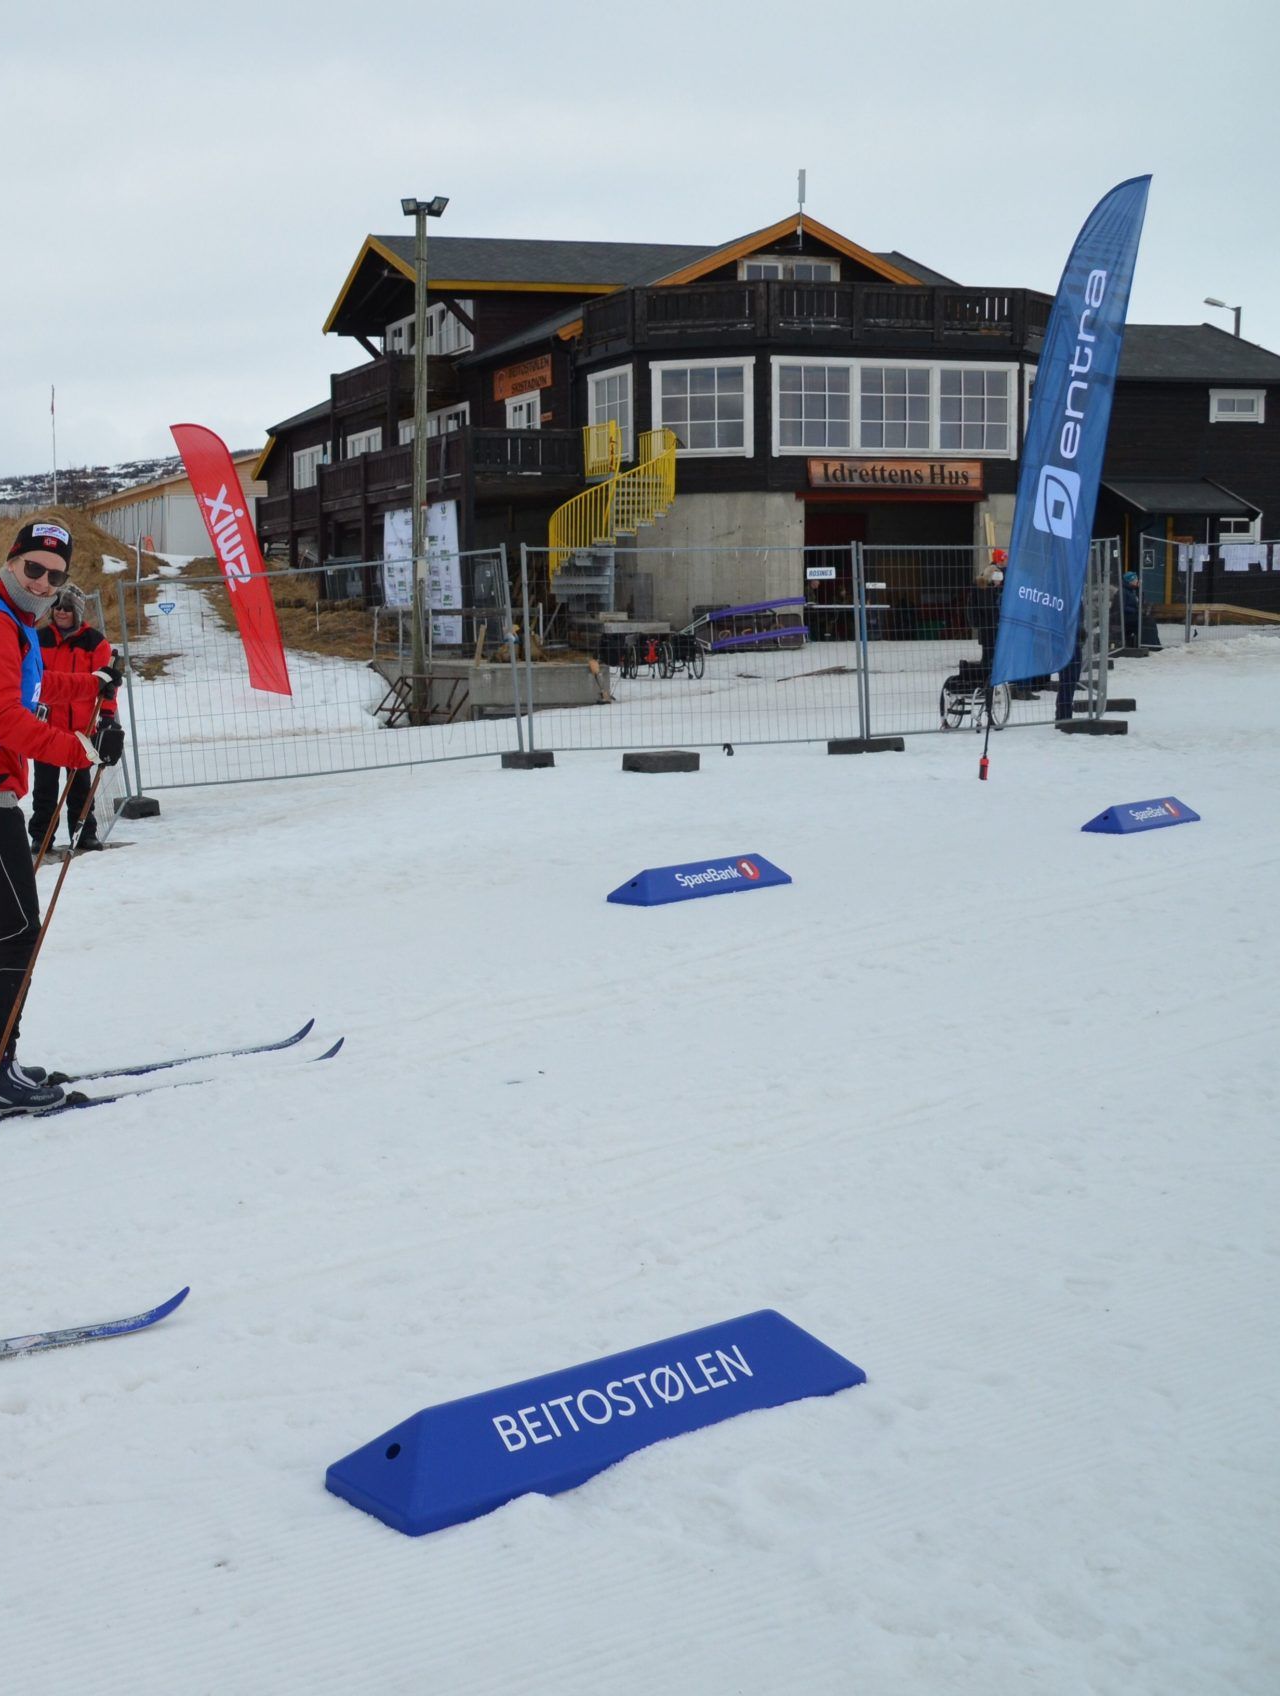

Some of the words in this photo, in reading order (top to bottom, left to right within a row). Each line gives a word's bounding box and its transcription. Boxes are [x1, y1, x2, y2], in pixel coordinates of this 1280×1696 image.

[1060, 269, 1107, 459] entra
[822, 463, 924, 484] Idrettens
[928, 464, 969, 486] Hus
[1018, 585, 1064, 611] entra.no
[675, 866, 741, 888] SpareBank
[491, 1344, 754, 1453] BEITOSTØLEN
